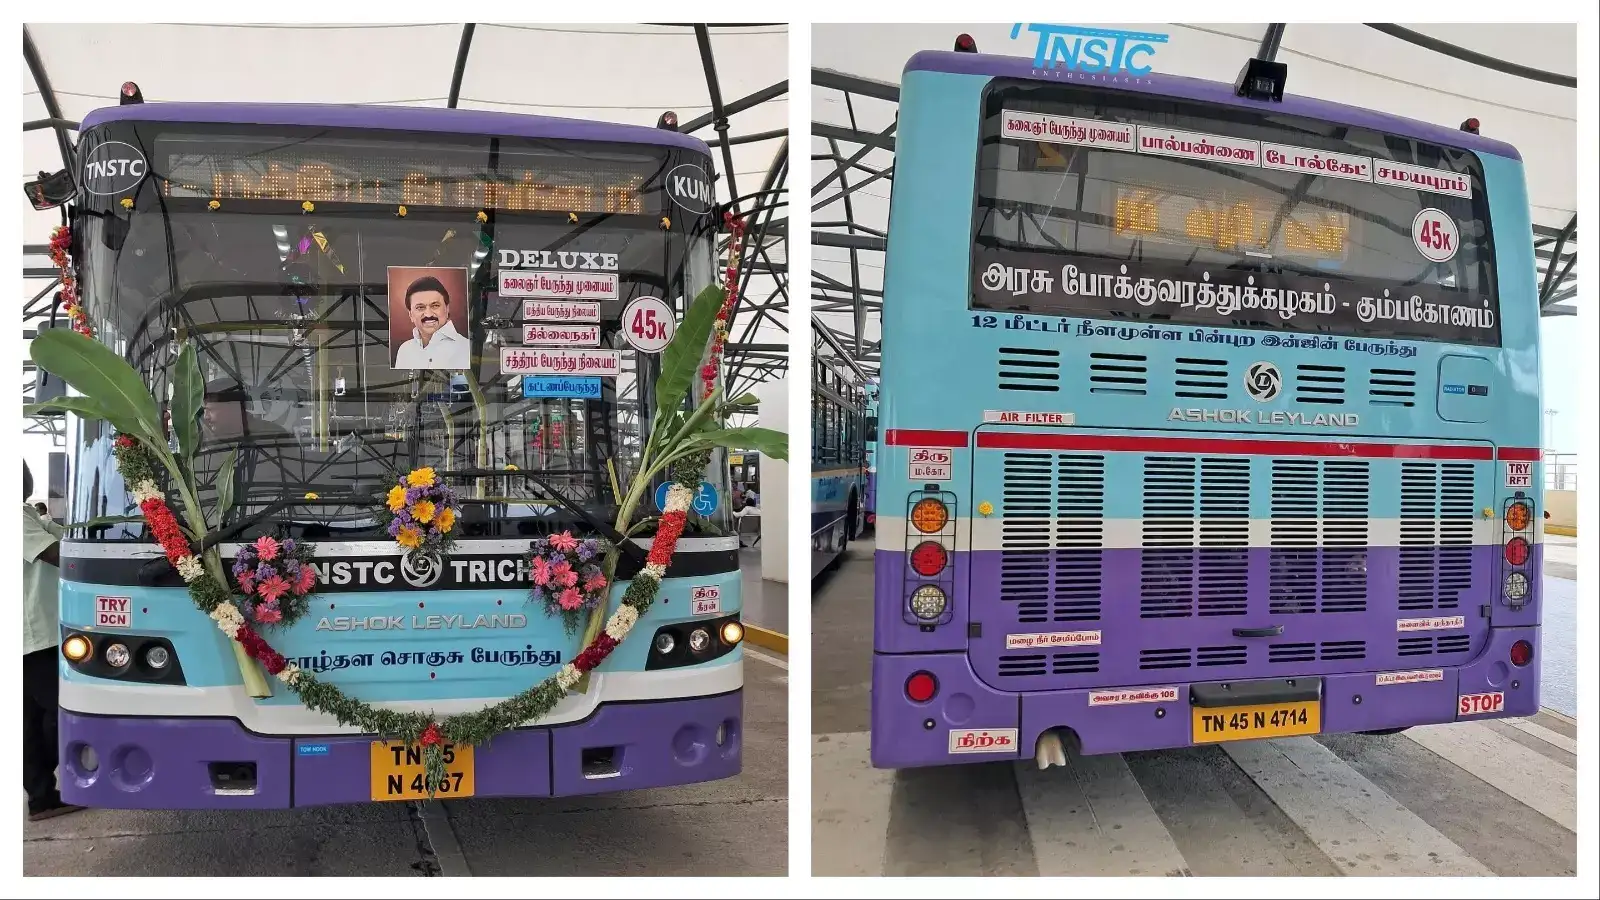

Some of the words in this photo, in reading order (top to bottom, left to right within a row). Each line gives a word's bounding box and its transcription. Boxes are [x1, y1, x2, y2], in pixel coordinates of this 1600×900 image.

[1007, 117, 1047, 135] கலைஞர்
[1049, 119, 1087, 143] பேருந்து
[1088, 127, 1131, 144] முனையம்
[1142, 134, 1255, 161] பால்பண்ணை
[86, 159, 143, 180] TNSTC
[1266, 149, 1369, 176] டோல்கேட்
[1378, 166, 1468, 192] சமயபுரம்
[674, 175, 711, 205] KUM
[1420, 219, 1452, 250] 45K
[498, 249, 619, 271] DELUXE
[504, 274, 538, 291] கலைஞர்
[540, 275, 574, 294] பேருந்து
[576, 277, 614, 294] முனையம்
[981, 262, 1055, 297] அரசு
[1061, 264, 1337, 320] போக்குவரத்துக்கழகம்
[1356, 288, 1495, 329] கும்பகோணம்
[527, 327, 597, 342] தில்லைநகர்
[631, 309, 667, 341] 45K
[971, 315, 998, 329] 12
[1005, 315, 1070, 333] மீட்டர்
[1076, 320, 1183, 341] நீளமுள்ள
[1188, 328, 1256, 348] பின்புற
[1261, 334, 1339, 351] இன்ஜின்
[1344, 339, 1418, 358] பேருந்து
[505, 351, 538, 370] சத்திரம்
[540, 352, 577, 371] பேருந்து
[578, 353, 617, 371] நிலையம்
[1000, 412, 1019, 422] AIR
[1025, 413, 1063, 423] FILTER
[1168, 407, 1252, 424] ASHOK
[1257, 410, 1360, 427] LEYLAND
[912, 450, 949, 463] திரு
[915, 466, 946, 476] ம.கோ.
[1509, 463, 1529, 474] TRY
[1509, 476, 1529, 485] RFT
[309, 561, 395, 585] NSTC
[450, 559, 535, 583] TRICH
[694, 588, 718, 600] திரு
[99, 598, 128, 613] TRY
[697, 601, 716, 612] தீரன்
[100, 613, 126, 625] DCN
[316, 616, 405, 632] ASHOK
[411, 614, 528, 630] LEYLAND
[381, 650, 464, 667] சொகுசு
[471, 646, 562, 667] பேருந்து
[1160, 690, 1175, 698] 108
[1461, 694, 1503, 713] STOP
[1202, 715, 1225, 732] TN
[1229, 713, 1249, 730] 45
[1254, 712, 1265, 728] N
[1270, 708, 1308, 727] 4714
[956, 732, 1011, 749] நிற்க
[391, 745, 420, 766] TN
[442, 744, 455, 764] 5
[387, 774, 403, 795] N
